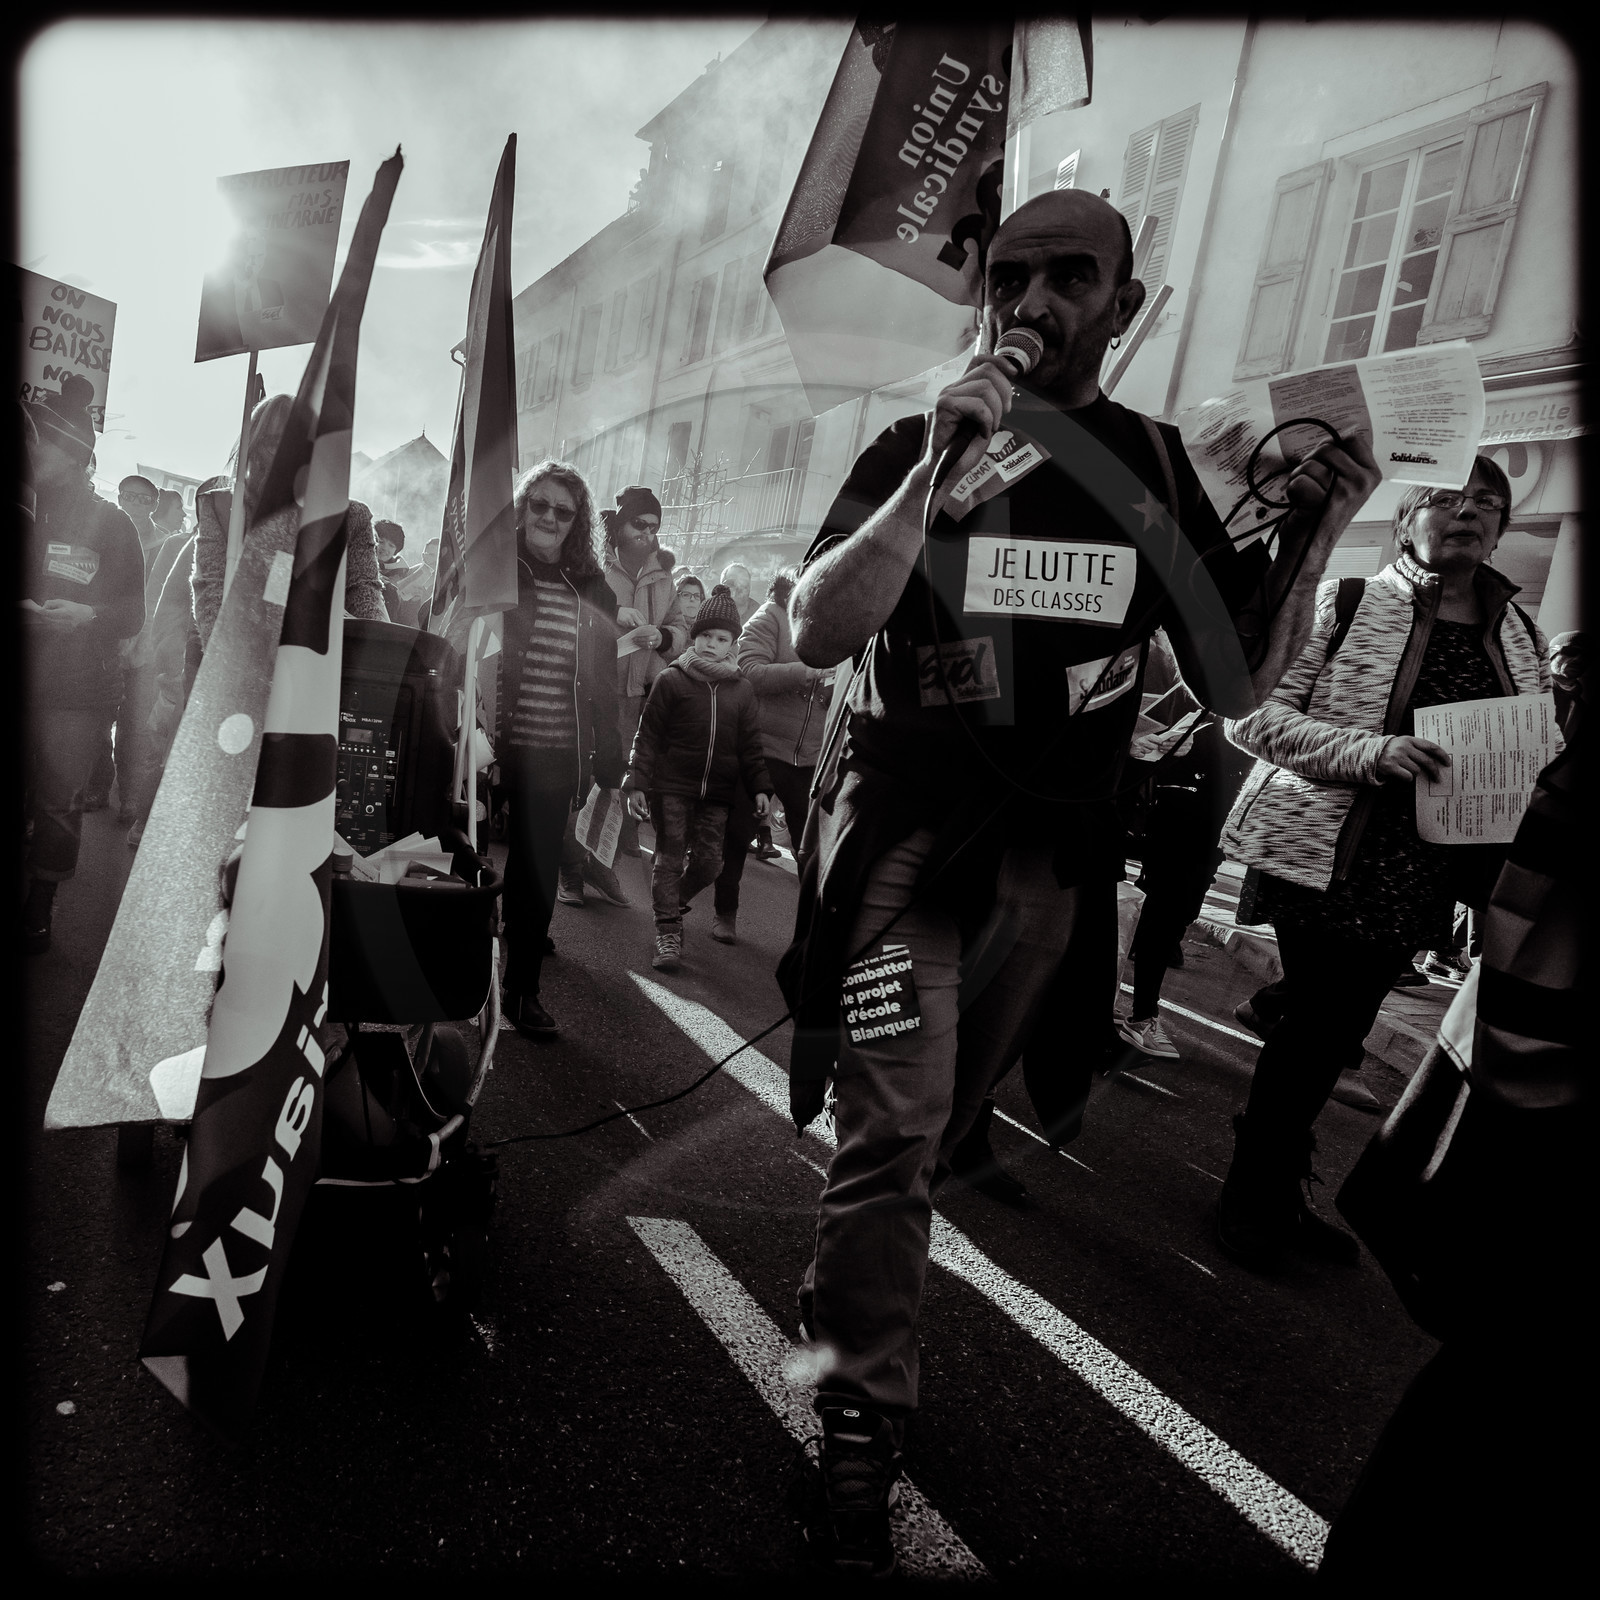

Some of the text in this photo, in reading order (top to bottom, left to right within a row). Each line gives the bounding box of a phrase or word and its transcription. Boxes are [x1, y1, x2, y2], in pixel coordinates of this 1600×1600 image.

[51, 285, 86, 309] ON
[42, 305, 105, 343] NOUS
[43, 364, 87, 385] NO
[1485, 404, 1571, 427] utuelle
[956, 484, 968, 495] LE
[965, 461, 992, 485] CLIMAT
[988, 548, 1117, 586] JE LUTTE
[993, 588, 1103, 613] DES CLASSES
[856, 980, 903, 1005] projet
[847, 1001, 902, 1024] d'école
[851, 1016, 921, 1043] Blanquer
